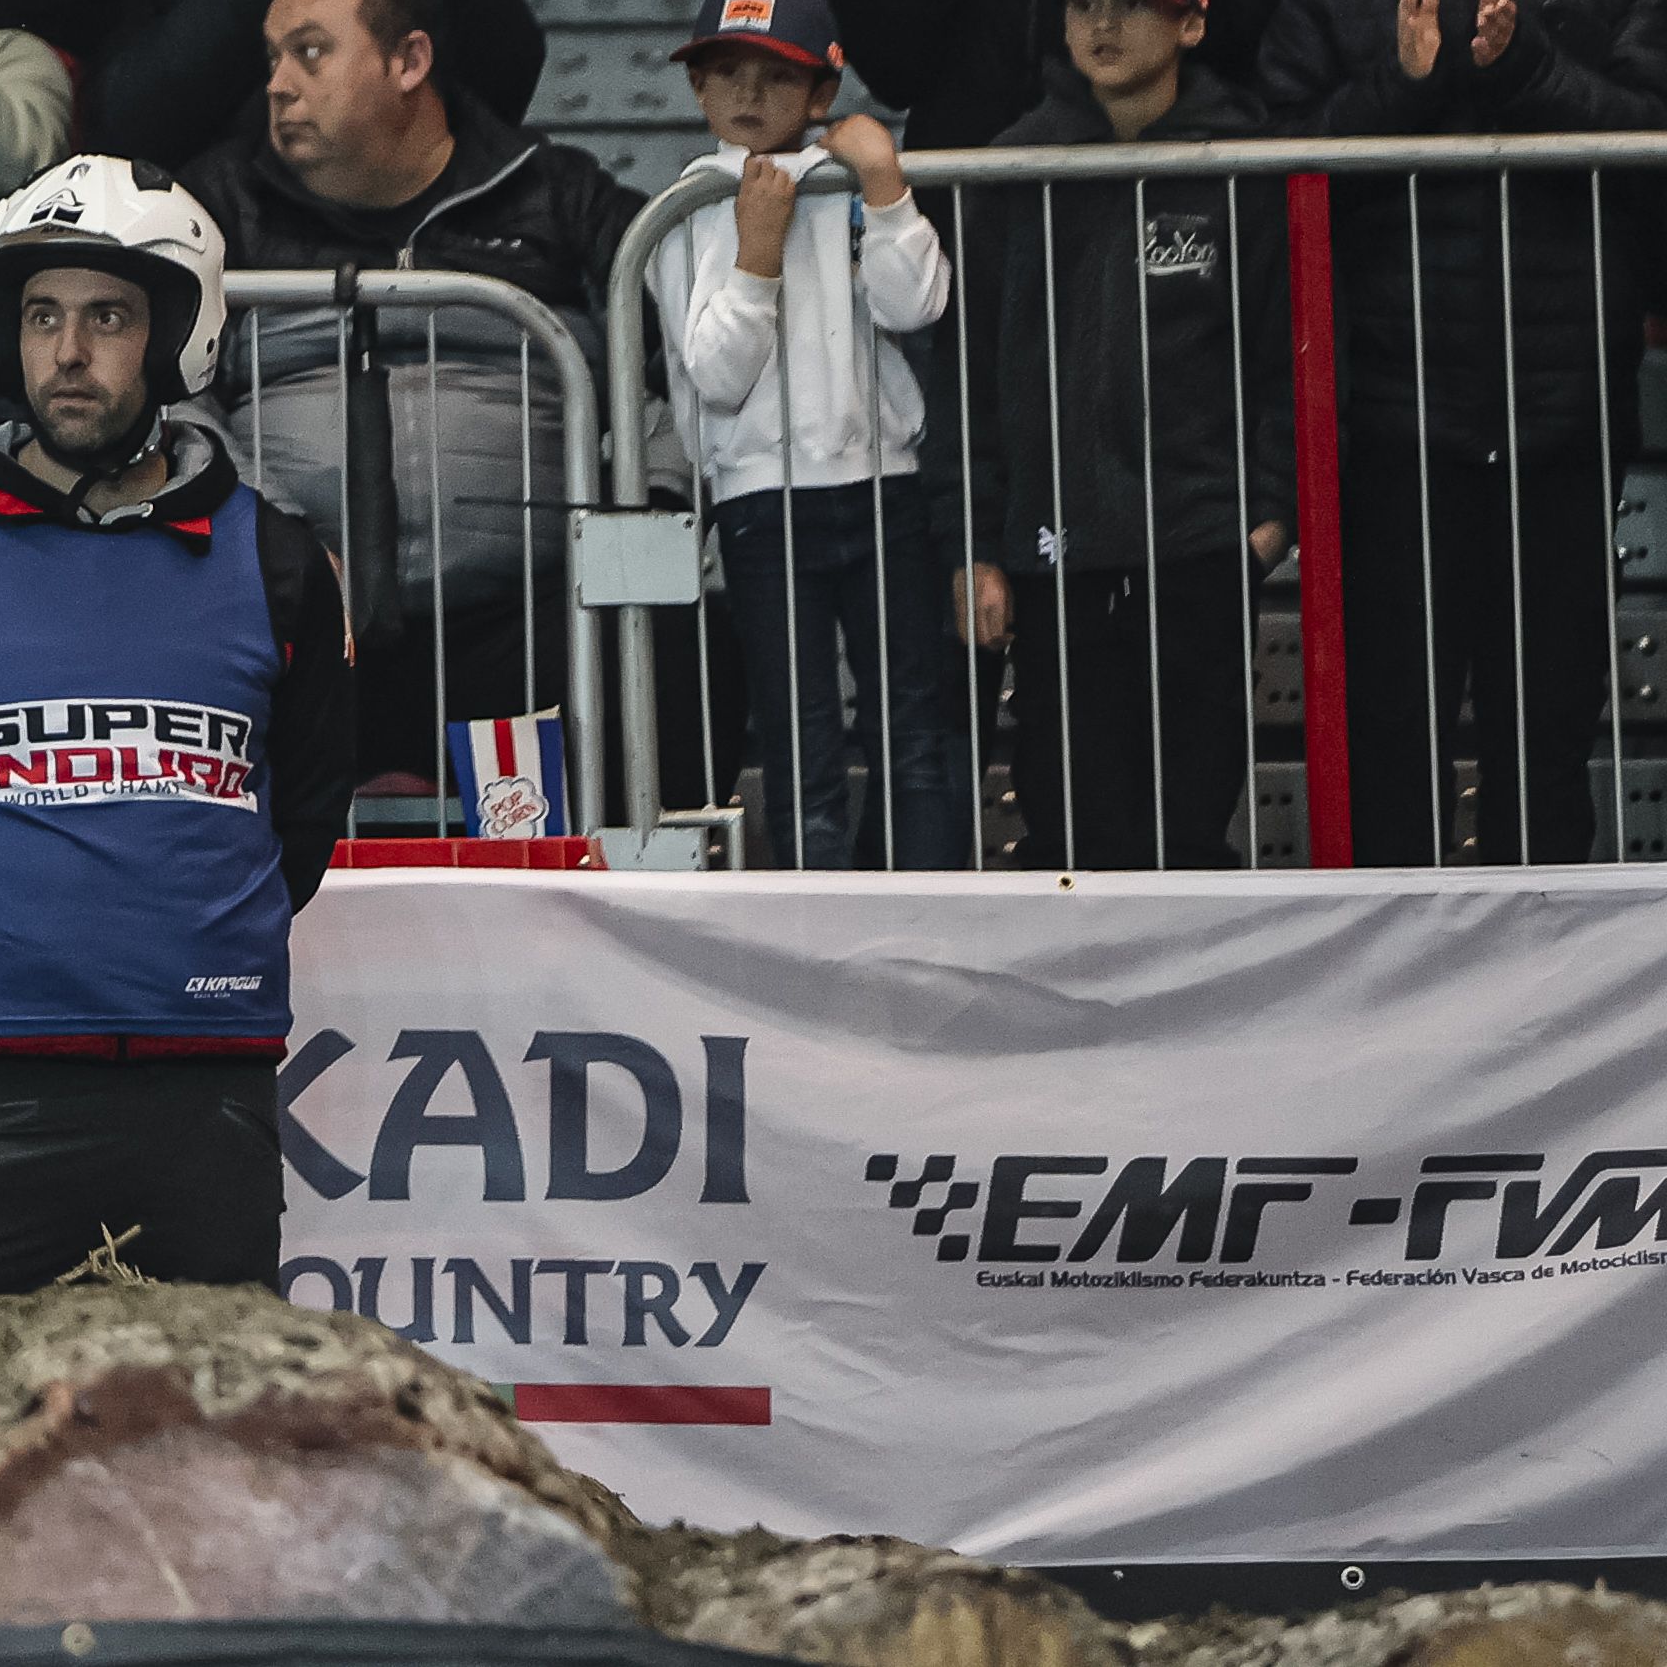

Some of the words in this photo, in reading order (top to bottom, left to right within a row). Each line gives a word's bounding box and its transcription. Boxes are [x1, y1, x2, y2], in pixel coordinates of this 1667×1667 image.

[4, 783, 89, 807] WORLD
[490, 790, 523, 818] POP
[976, 1270, 1044, 1288] Euskal
[1051, 1270, 1183, 1288] Motoziklismo
[1189, 1270, 1326, 1288] Federakuntza
[1346, 1268, 1456, 1287] Federación
[1462, 1267, 1525, 1284] Vasca
[1531, 1264, 1554, 1280] de
